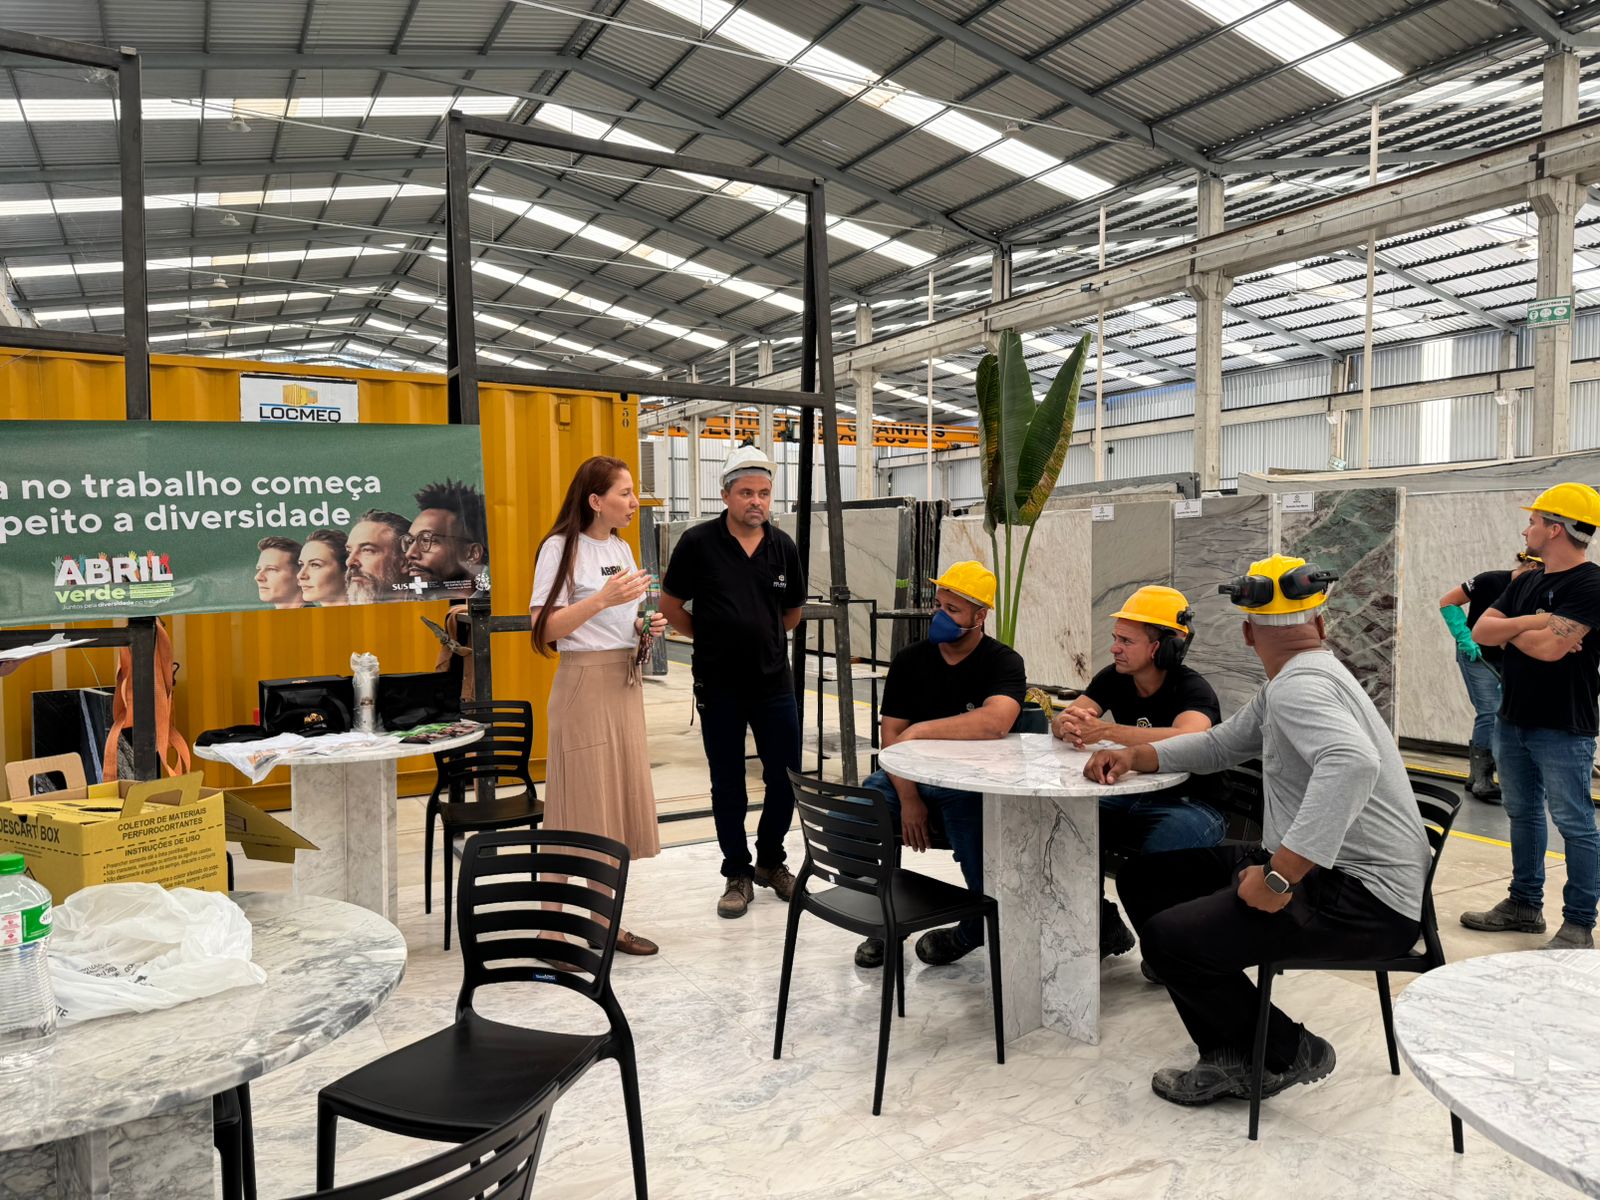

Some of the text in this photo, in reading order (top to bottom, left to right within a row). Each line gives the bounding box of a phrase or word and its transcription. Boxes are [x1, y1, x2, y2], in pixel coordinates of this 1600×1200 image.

[259, 407, 341, 423] LOCMEQ
[21, 479, 72, 499] no
[81, 470, 242, 499] trabalho
[251, 475, 381, 501] começa
[0, 501, 350, 544] peito a diversidade
[54, 555, 174, 587] ABRIL
[54, 584, 126, 604] verde
[391, 582, 409, 591] SUS
[117, 807, 207, 832] COLETOR DE MATERIAIS
[122, 817, 203, 841] PERFUROCORTANTES
[40, 825, 60, 844] BOX
[125, 834, 201, 857] INSTRUÇÕES DE USO
